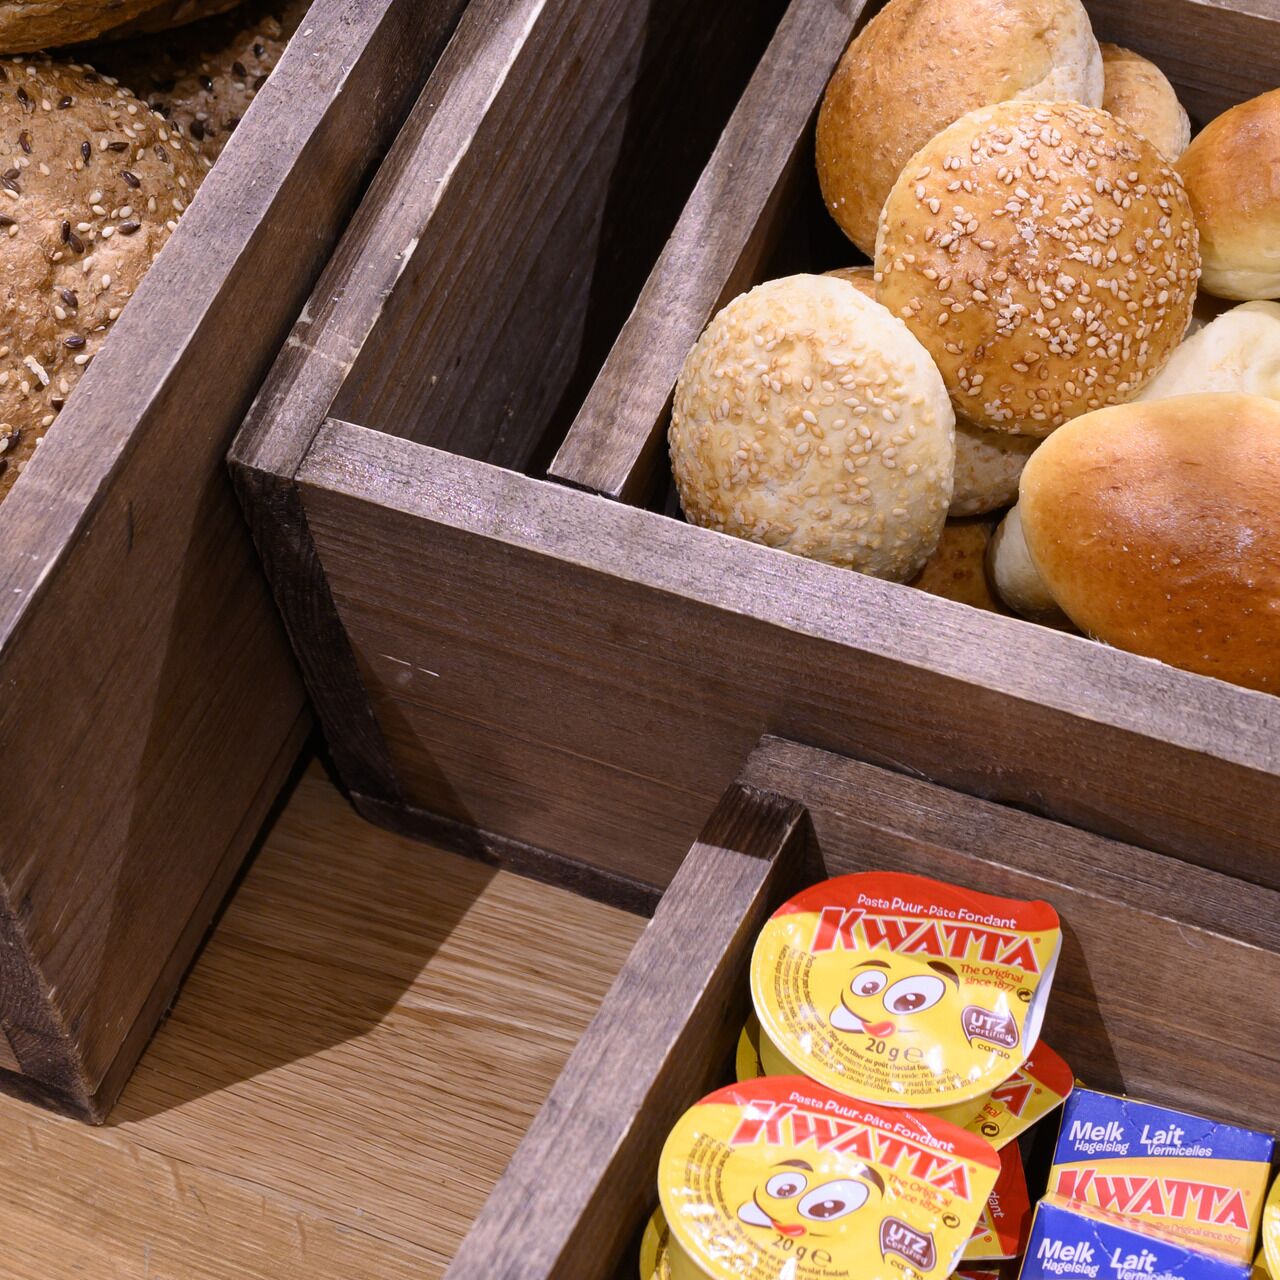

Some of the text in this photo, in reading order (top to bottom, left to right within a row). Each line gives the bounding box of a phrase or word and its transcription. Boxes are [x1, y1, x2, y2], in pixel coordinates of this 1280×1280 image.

[858, 894, 1017, 929] Pasta Puur Pâte Fondant
[810, 906, 1041, 974] KWATTA
[960, 964, 1024, 984] The Original
[965, 975, 1016, 993] since 1877
[969, 1025, 1015, 1043] Certified
[971, 1012, 1008, 1033] UTZ
[865, 1037, 900, 1062] 20 g
[789, 1091, 954, 1153] Pasta Puur Pâte Fondant
[1069, 1121, 1185, 1146] Melk Lait
[730, 1099, 971, 1201] KWATTA
[1074, 1139, 1213, 1157] Hagelslag Vermicelles
[889, 1173, 908, 1187] The
[1056, 1168, 1252, 1231] KWATTA
[772, 1233, 808, 1261] 20 g
[889, 1223, 927, 1254] UTZ
[1037, 1238, 1158, 1272] Melk Lait
[1041, 1261, 1100, 1278] Hagelslag
